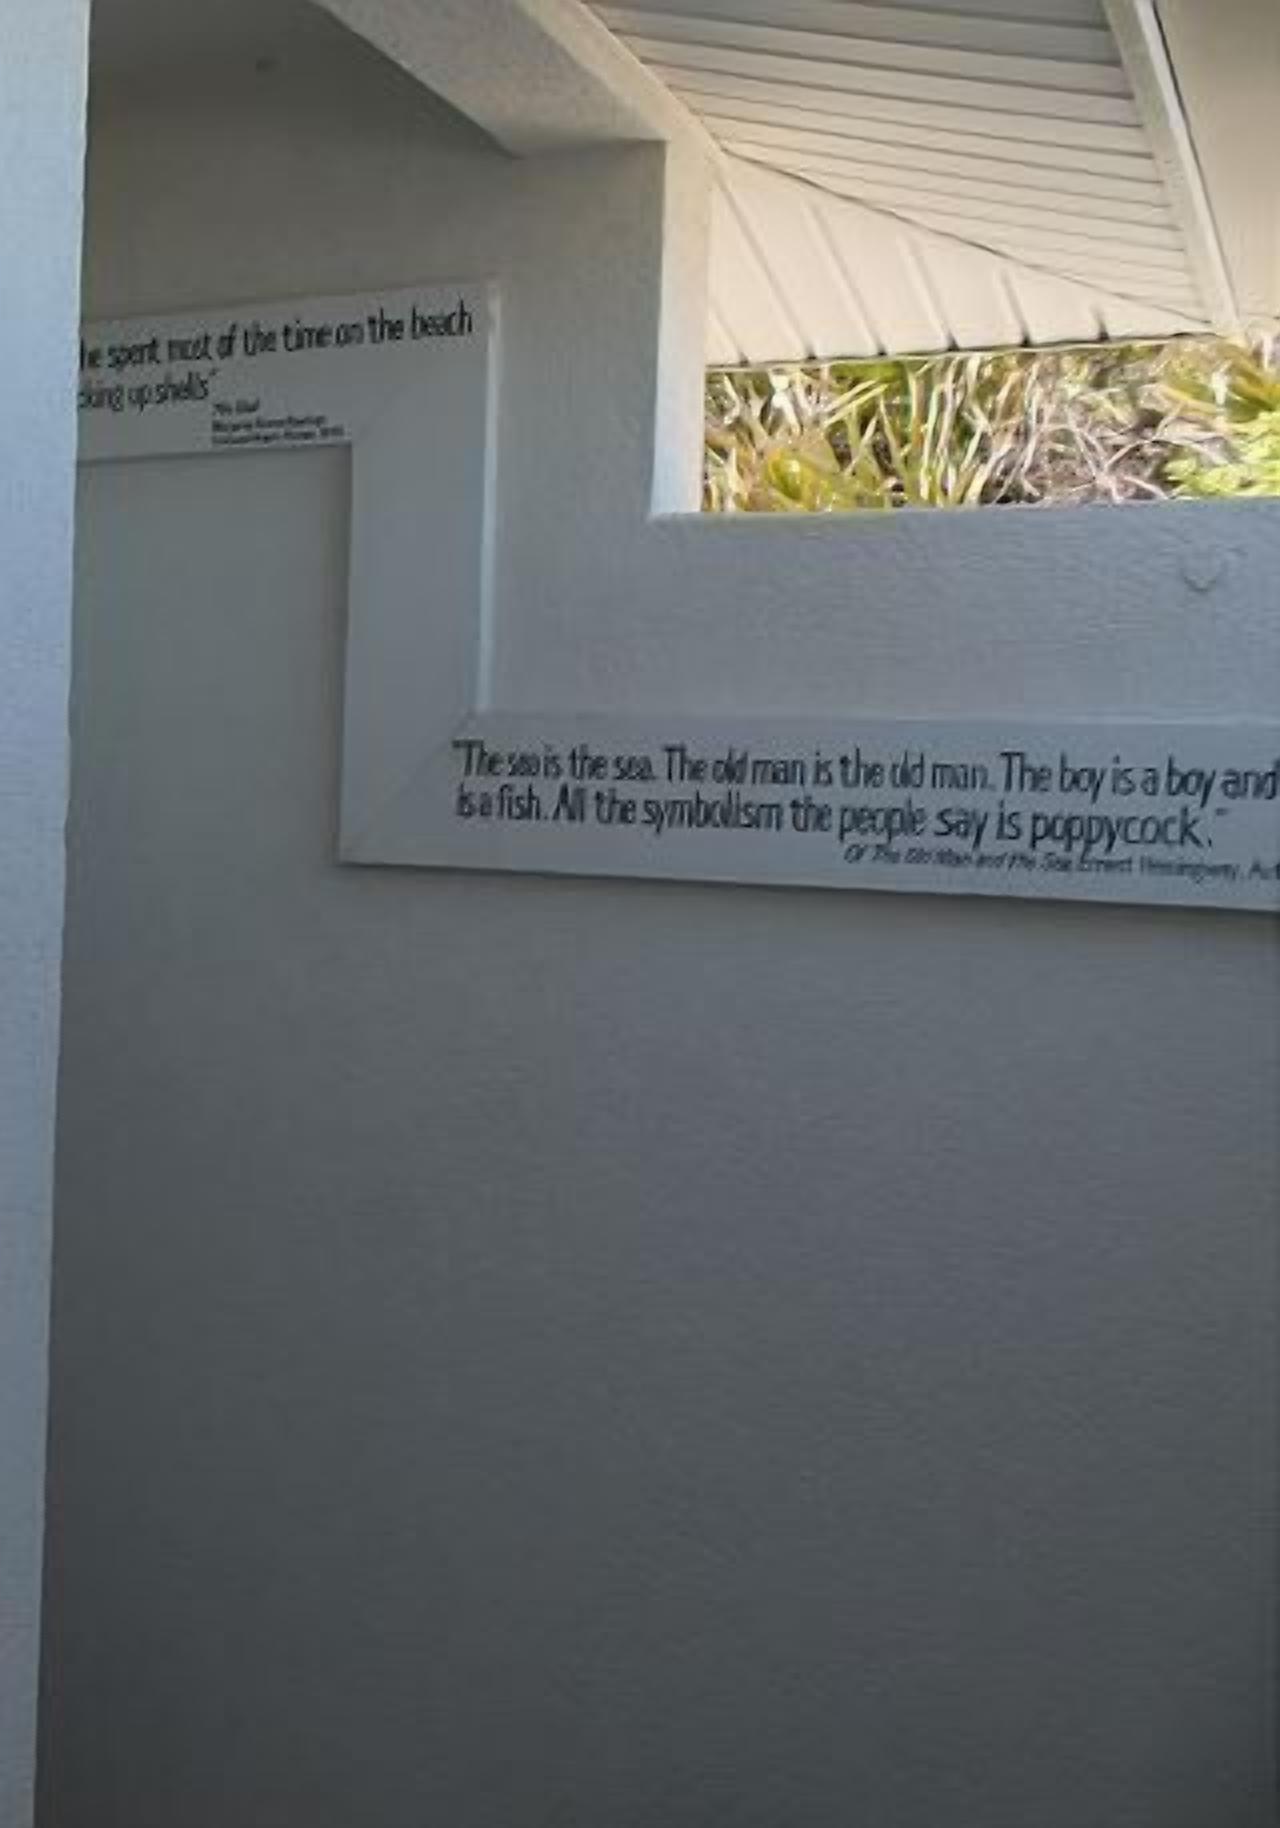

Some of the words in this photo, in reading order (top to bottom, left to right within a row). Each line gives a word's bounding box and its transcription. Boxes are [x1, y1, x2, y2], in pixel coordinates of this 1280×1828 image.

[107, 337, 161, 373] spent
[168, 331, 212, 361] most
[217, 322, 237, 360] of
[243, 321, 277, 356] the
[283, 317, 332, 352] time
[334, 322, 365, 347] on
[368, 306, 405, 345] the
[411, 297, 473, 341] beach
[127, 384, 151, 415] up
[507, 753, 541, 777] sea
[543, 744, 563, 778] is
[569, 744, 608, 780] the
[613, 755, 656, 781] sea.
[664, 745, 707, 782] The
[712, 749, 749, 785] old
[752, 760, 805, 787] man
[813, 752, 833, 786] is
[839, 746, 885, 789] the
[891, 750, 924, 789] old
[932, 764, 996, 791] man.
[999, 751, 1051, 792] The
[1059, 753, 1107, 804] boy
[1111, 754, 1136, 796] is
[1140, 767, 1159, 797] a
[1166, 756, 1216, 808] boy
[1222, 759, 1280, 800] and
[479, 792, 492, 817] a
[497, 783, 549, 821] fish.
[551, 784, 586, 823] All
[594, 788, 637, 825] the
[641, 789, 783, 836] symbolism
[789, 796, 833, 833] the
[838, 797, 926, 845] people
[934, 807, 989, 851] say
[996, 800, 1022, 841] is
